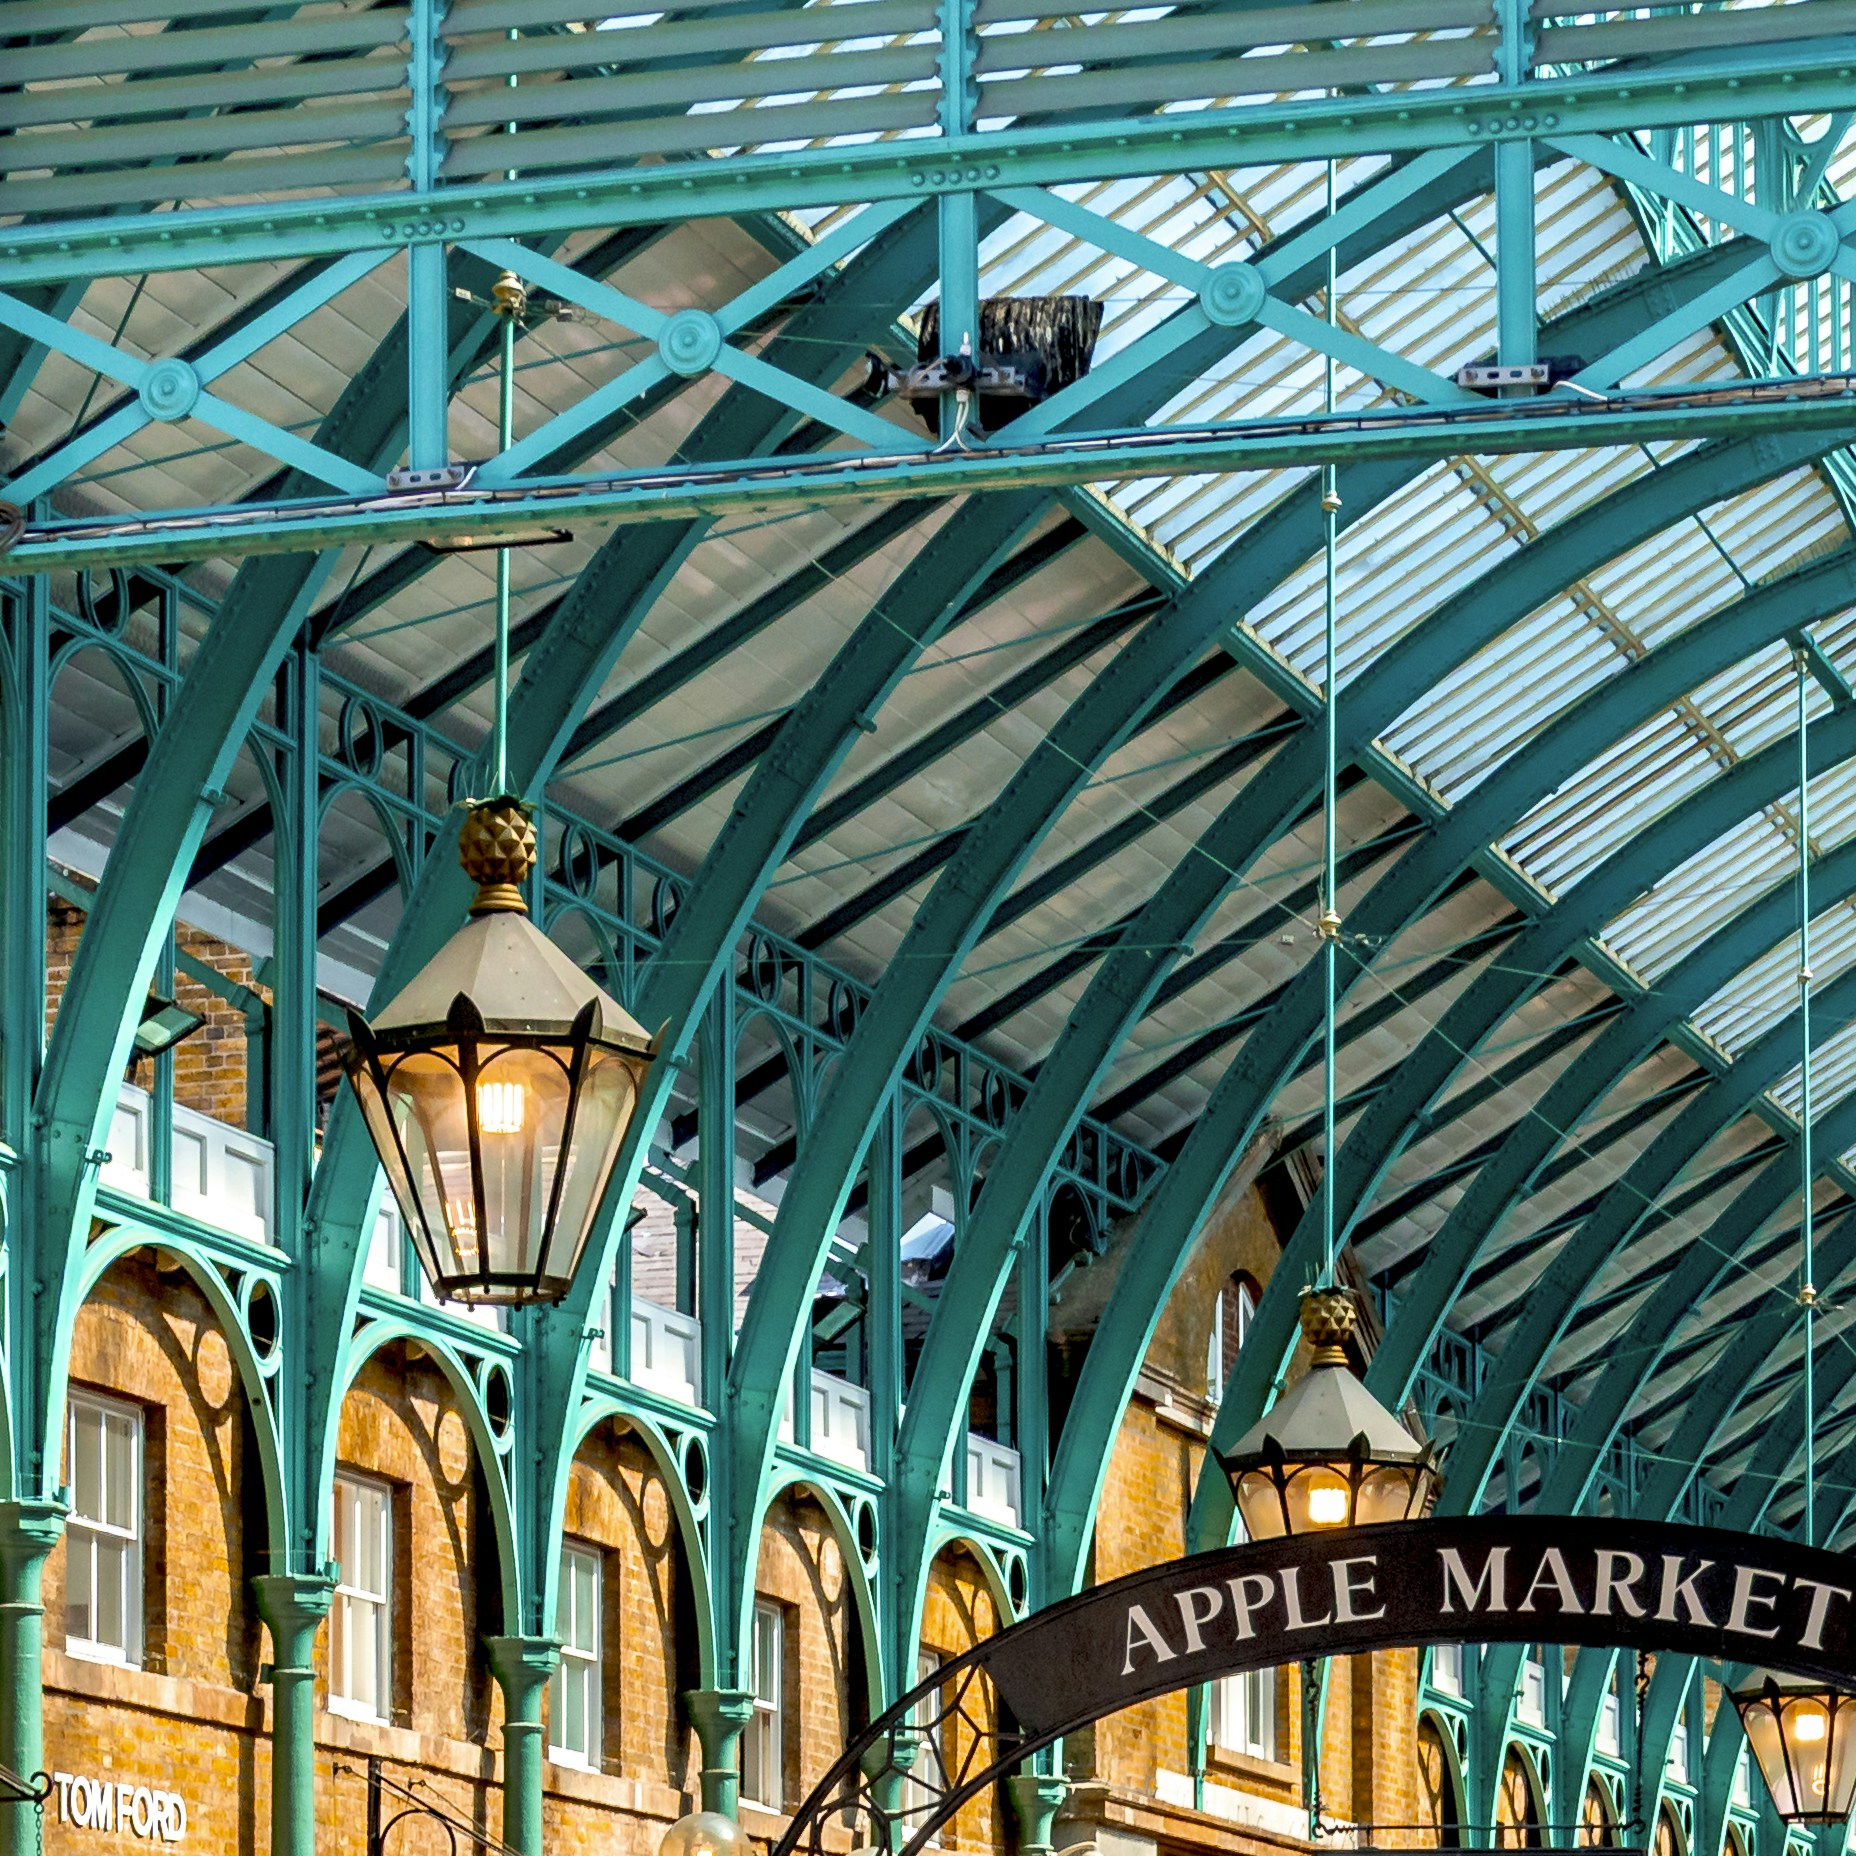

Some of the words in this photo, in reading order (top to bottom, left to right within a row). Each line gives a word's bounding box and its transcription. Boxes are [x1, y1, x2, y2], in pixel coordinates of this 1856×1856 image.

[1121, 1555, 1387, 1676] APPLE
[1436, 1547, 1852, 1651] MARKET
[54, 1771, 113, 1831] TOM
[116, 1783, 187, 1841] FORD
